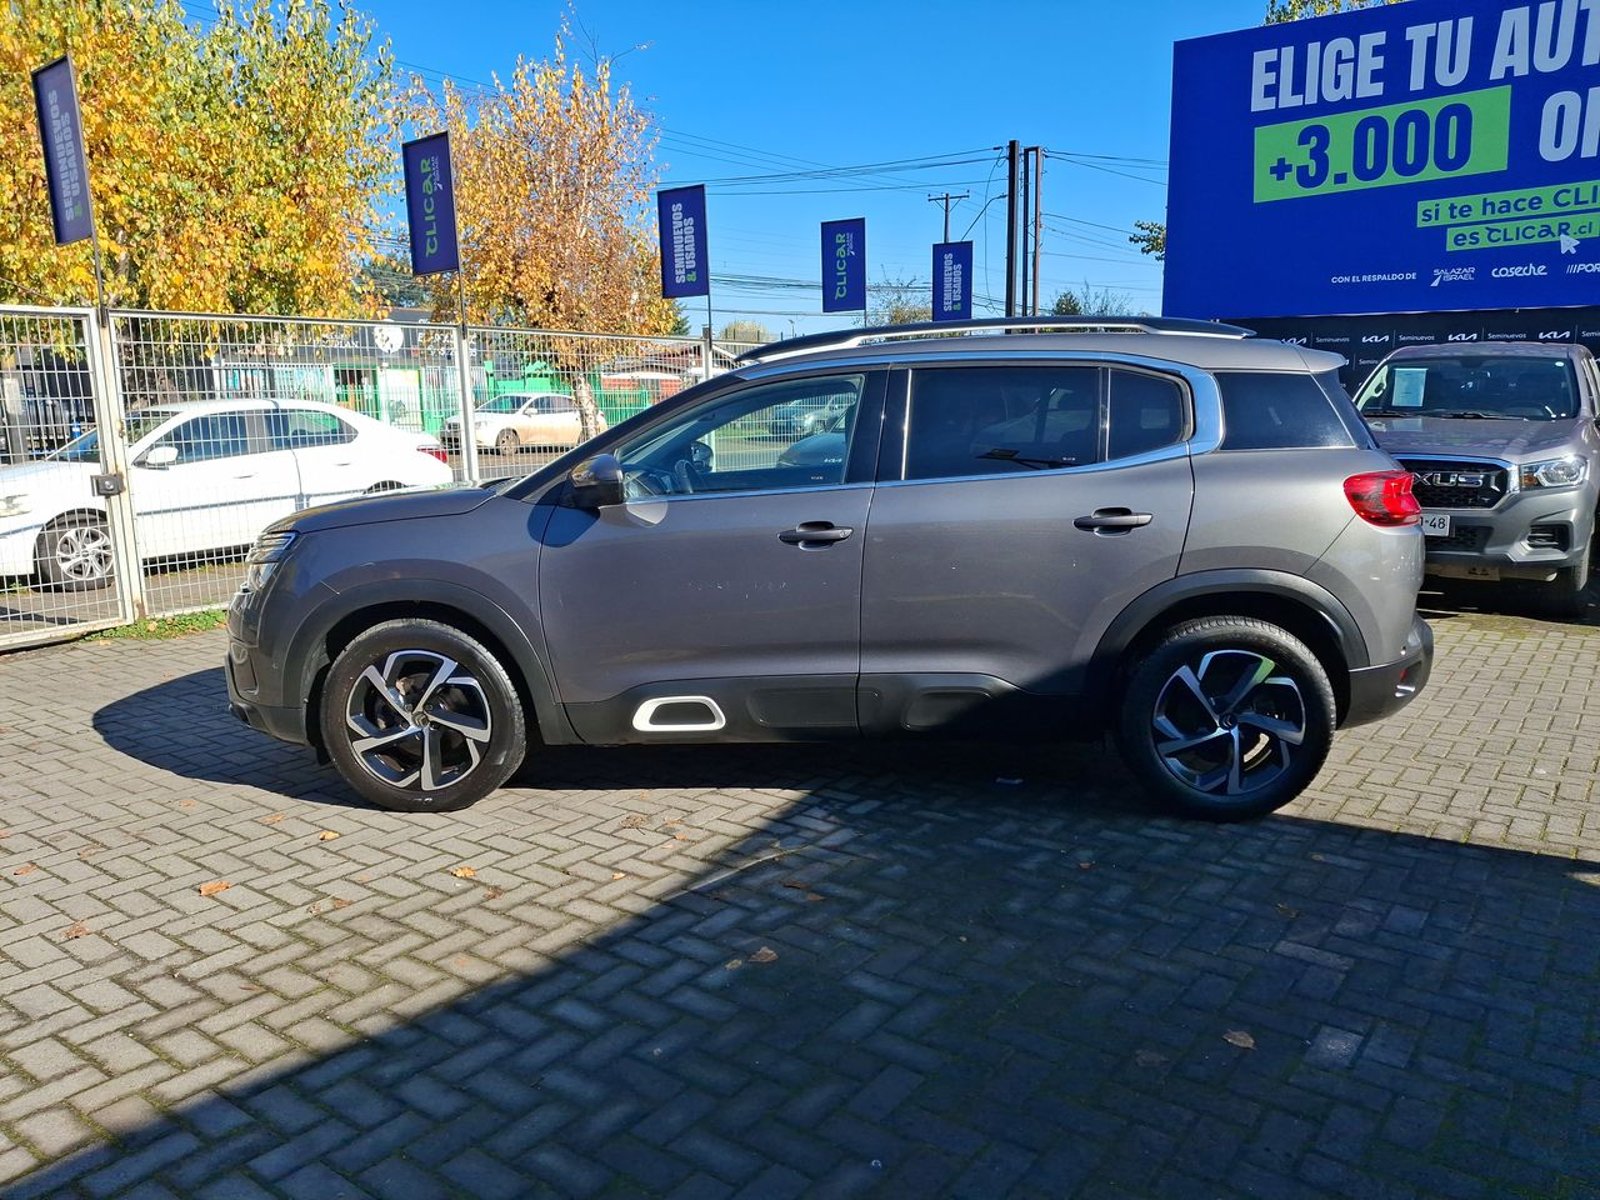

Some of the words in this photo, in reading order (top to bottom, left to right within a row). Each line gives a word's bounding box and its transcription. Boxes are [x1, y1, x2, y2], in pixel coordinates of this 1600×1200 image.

[1251, 31, 1387, 112] ELIGE
[1405, 16, 1473, 91] TU
[48, 90, 74, 222] SEMINUEVOS
[61, 112, 80, 197] USADOS
[1269, 103, 1473, 189] +3.000
[1421, 203, 1440, 222] si
[1448, 201, 1473, 219] te
[1482, 195, 1543, 216] hace
[672, 203, 685, 284] SEMINUEVOS
[684, 217, 696, 269] USADOS
[1453, 231, 1480, 247] es
[943, 253, 953, 312] SEMINUEVOS
[953, 263, 962, 301] USADOS
[1351, 275, 1361, 283] EL
[1362, 273, 1405, 282] RESPALDO
[1405, 272, 1417, 280] DE
[1433, 267, 1476, 276] SALAZAR
[1491, 263, 1548, 277] coseche
[1361, 334, 1390, 343] KIA
[1398, 334, 1436, 342] Seminuevos
[1448, 333, 1478, 341] KIA
[1487, 332, 1527, 340] Seminuevos
[1538, 330, 1571, 339] KIA
[1413, 472, 1485, 487] XUS
